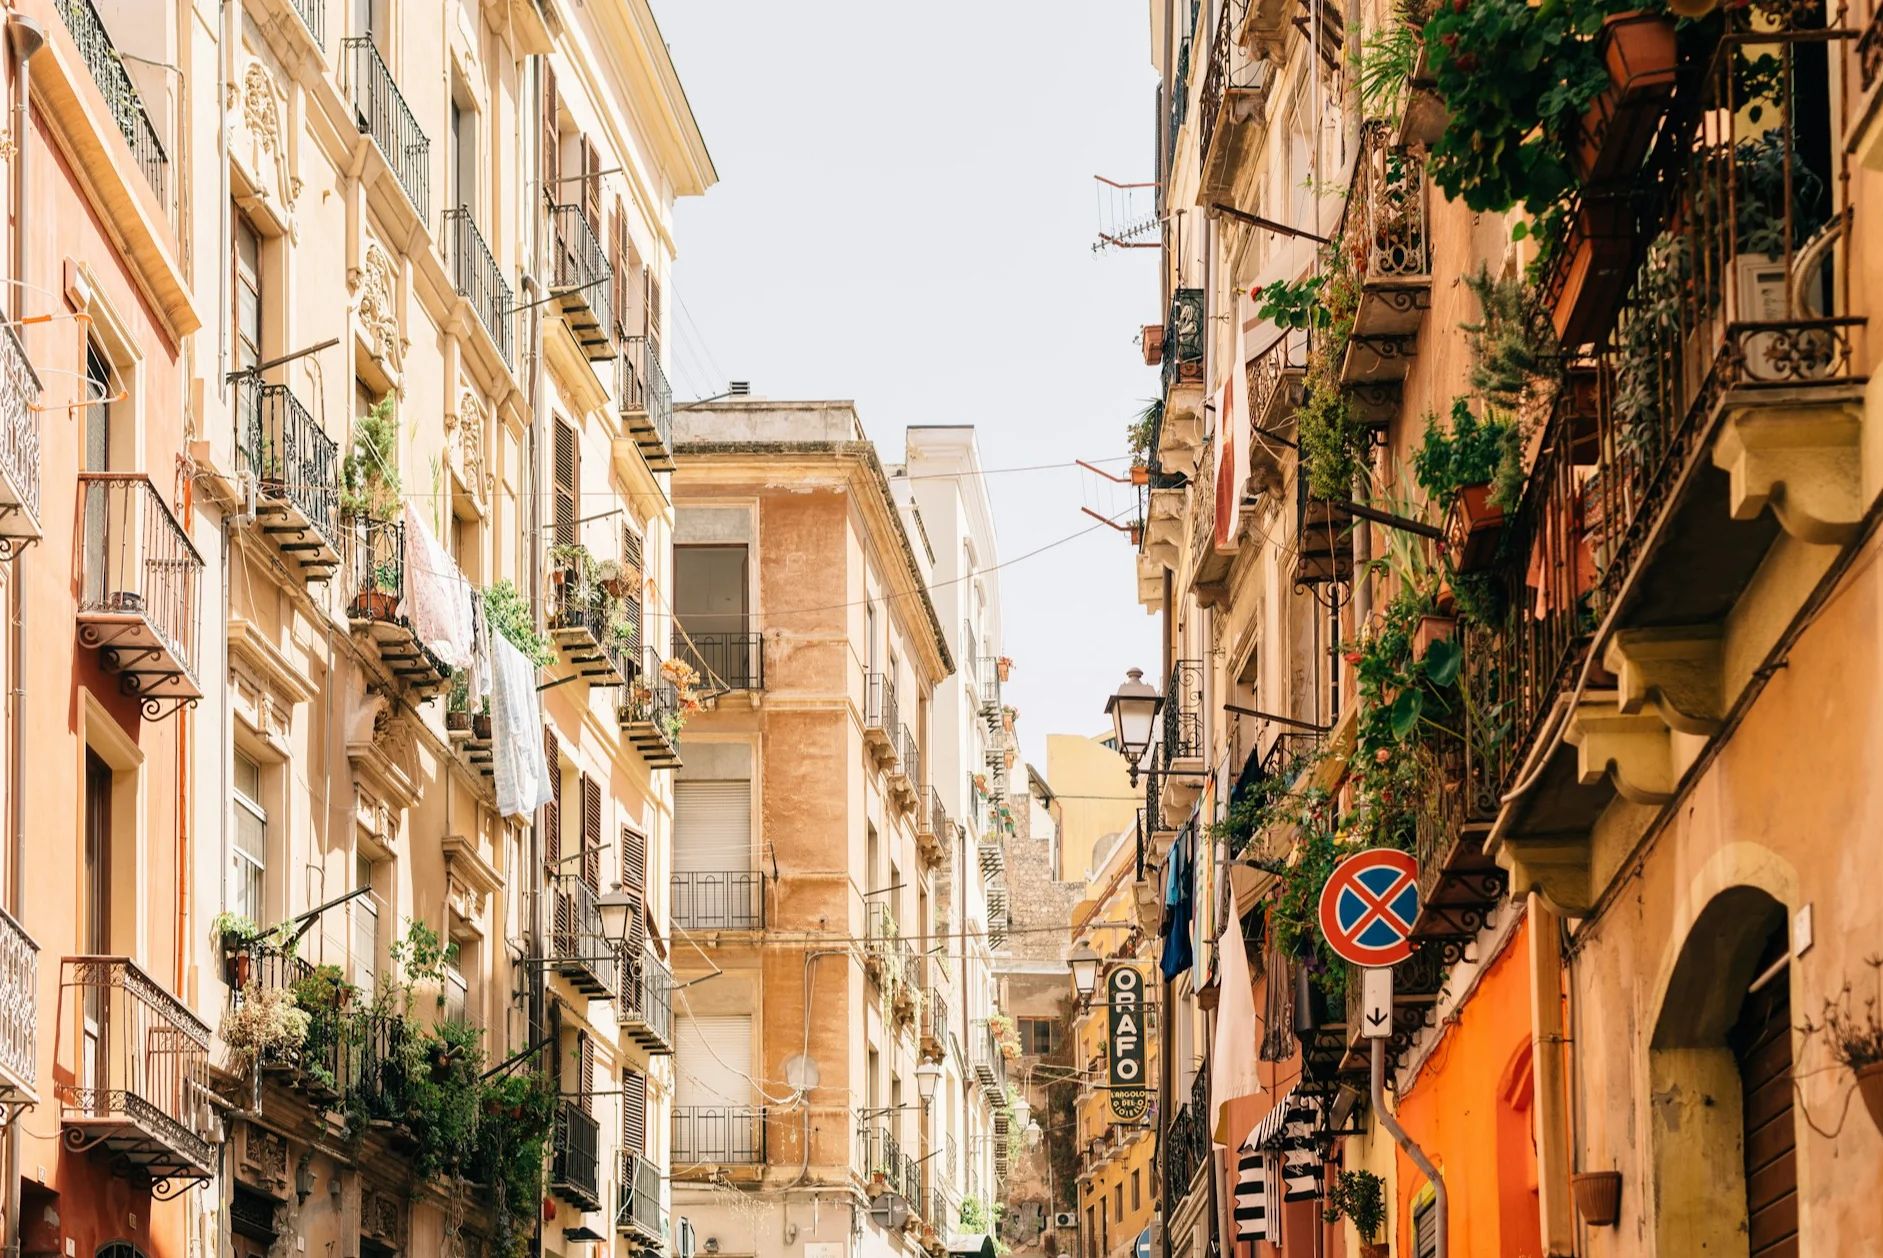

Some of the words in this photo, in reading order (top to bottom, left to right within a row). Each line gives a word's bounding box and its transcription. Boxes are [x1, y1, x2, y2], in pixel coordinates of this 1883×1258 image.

[1114, 969, 1139, 1080] ORAFO
[1111, 1091, 1146, 1099] L'ANGOLO
[1112, 1099, 1144, 1117] GIOIELLO
